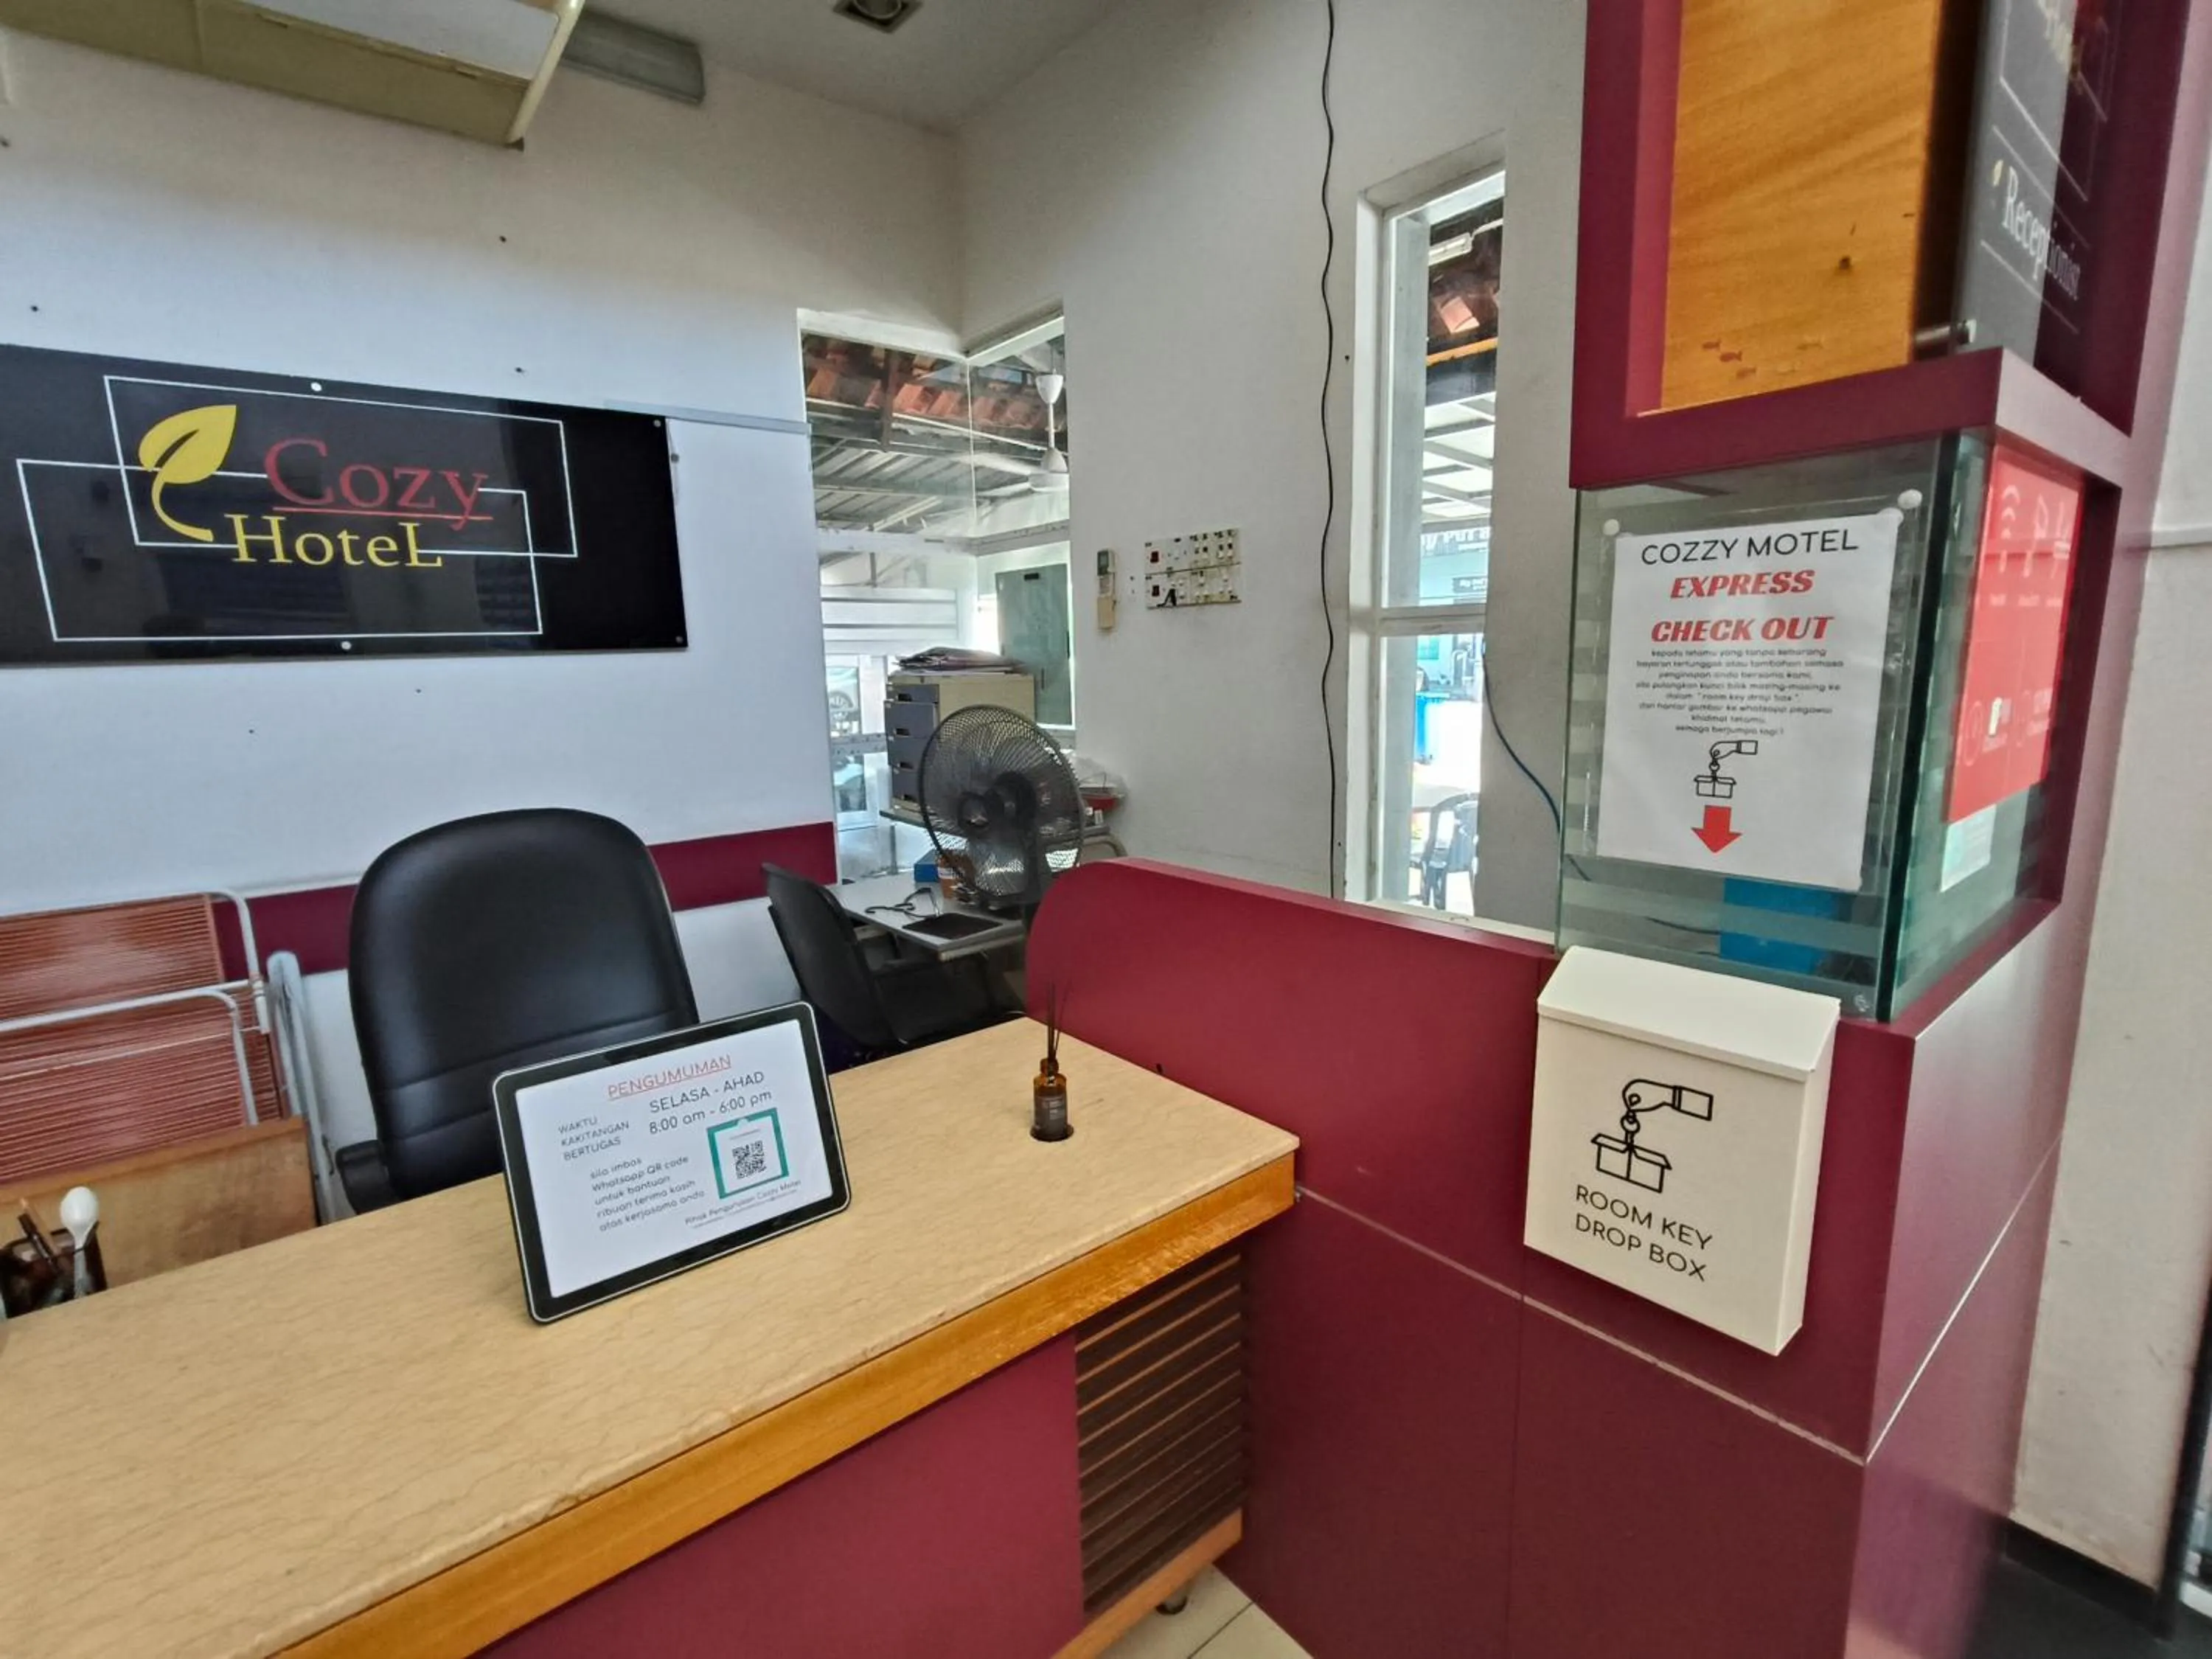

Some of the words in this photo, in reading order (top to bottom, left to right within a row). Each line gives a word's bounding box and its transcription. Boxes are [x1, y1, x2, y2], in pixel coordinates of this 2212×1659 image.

[264, 437, 488, 531] Cozy
[1641, 538, 1739, 565] COZZY
[1747, 529, 1859, 557] MOTEL
[1670, 569, 1815, 599] EXPRESS
[1651, 619, 1756, 642] CHECK
[1761, 616, 1835, 641] OUT
[608, 1054, 732, 1099] PENGUMUMAN
[650, 1087, 710, 1113] SELASA
[723, 1071, 765, 1093] AHAD
[558, 1116, 597, 1133] WAKTU
[650, 1116, 678, 1135] 8:00
[682, 1110, 705, 1124] am
[719, 1096, 745, 1114] 6:00
[750, 1091, 772, 1107] pm
[561, 1121, 629, 1147] KAKITANGAN
[563, 1137, 621, 1161] BERTUGAS
[647, 1163, 662, 1175] QR
[664, 1156, 689, 1169] code
[594, 1191, 625, 1206] untuk
[627, 1175, 670, 1194] bantuan
[635, 1189, 668, 1206] terima
[669, 1180, 696, 1193] kasih
[599, 1218, 624, 1232] atas
[625, 1200, 678, 1222] kerjasama
[679, 1190, 705, 1204] anda
[1575, 1183, 1654, 1229] ROOM
[1661, 1217, 1714, 1251] KEY
[1575, 1213, 1642, 1251] DROP
[1649, 1242, 1708, 1282] BOX
